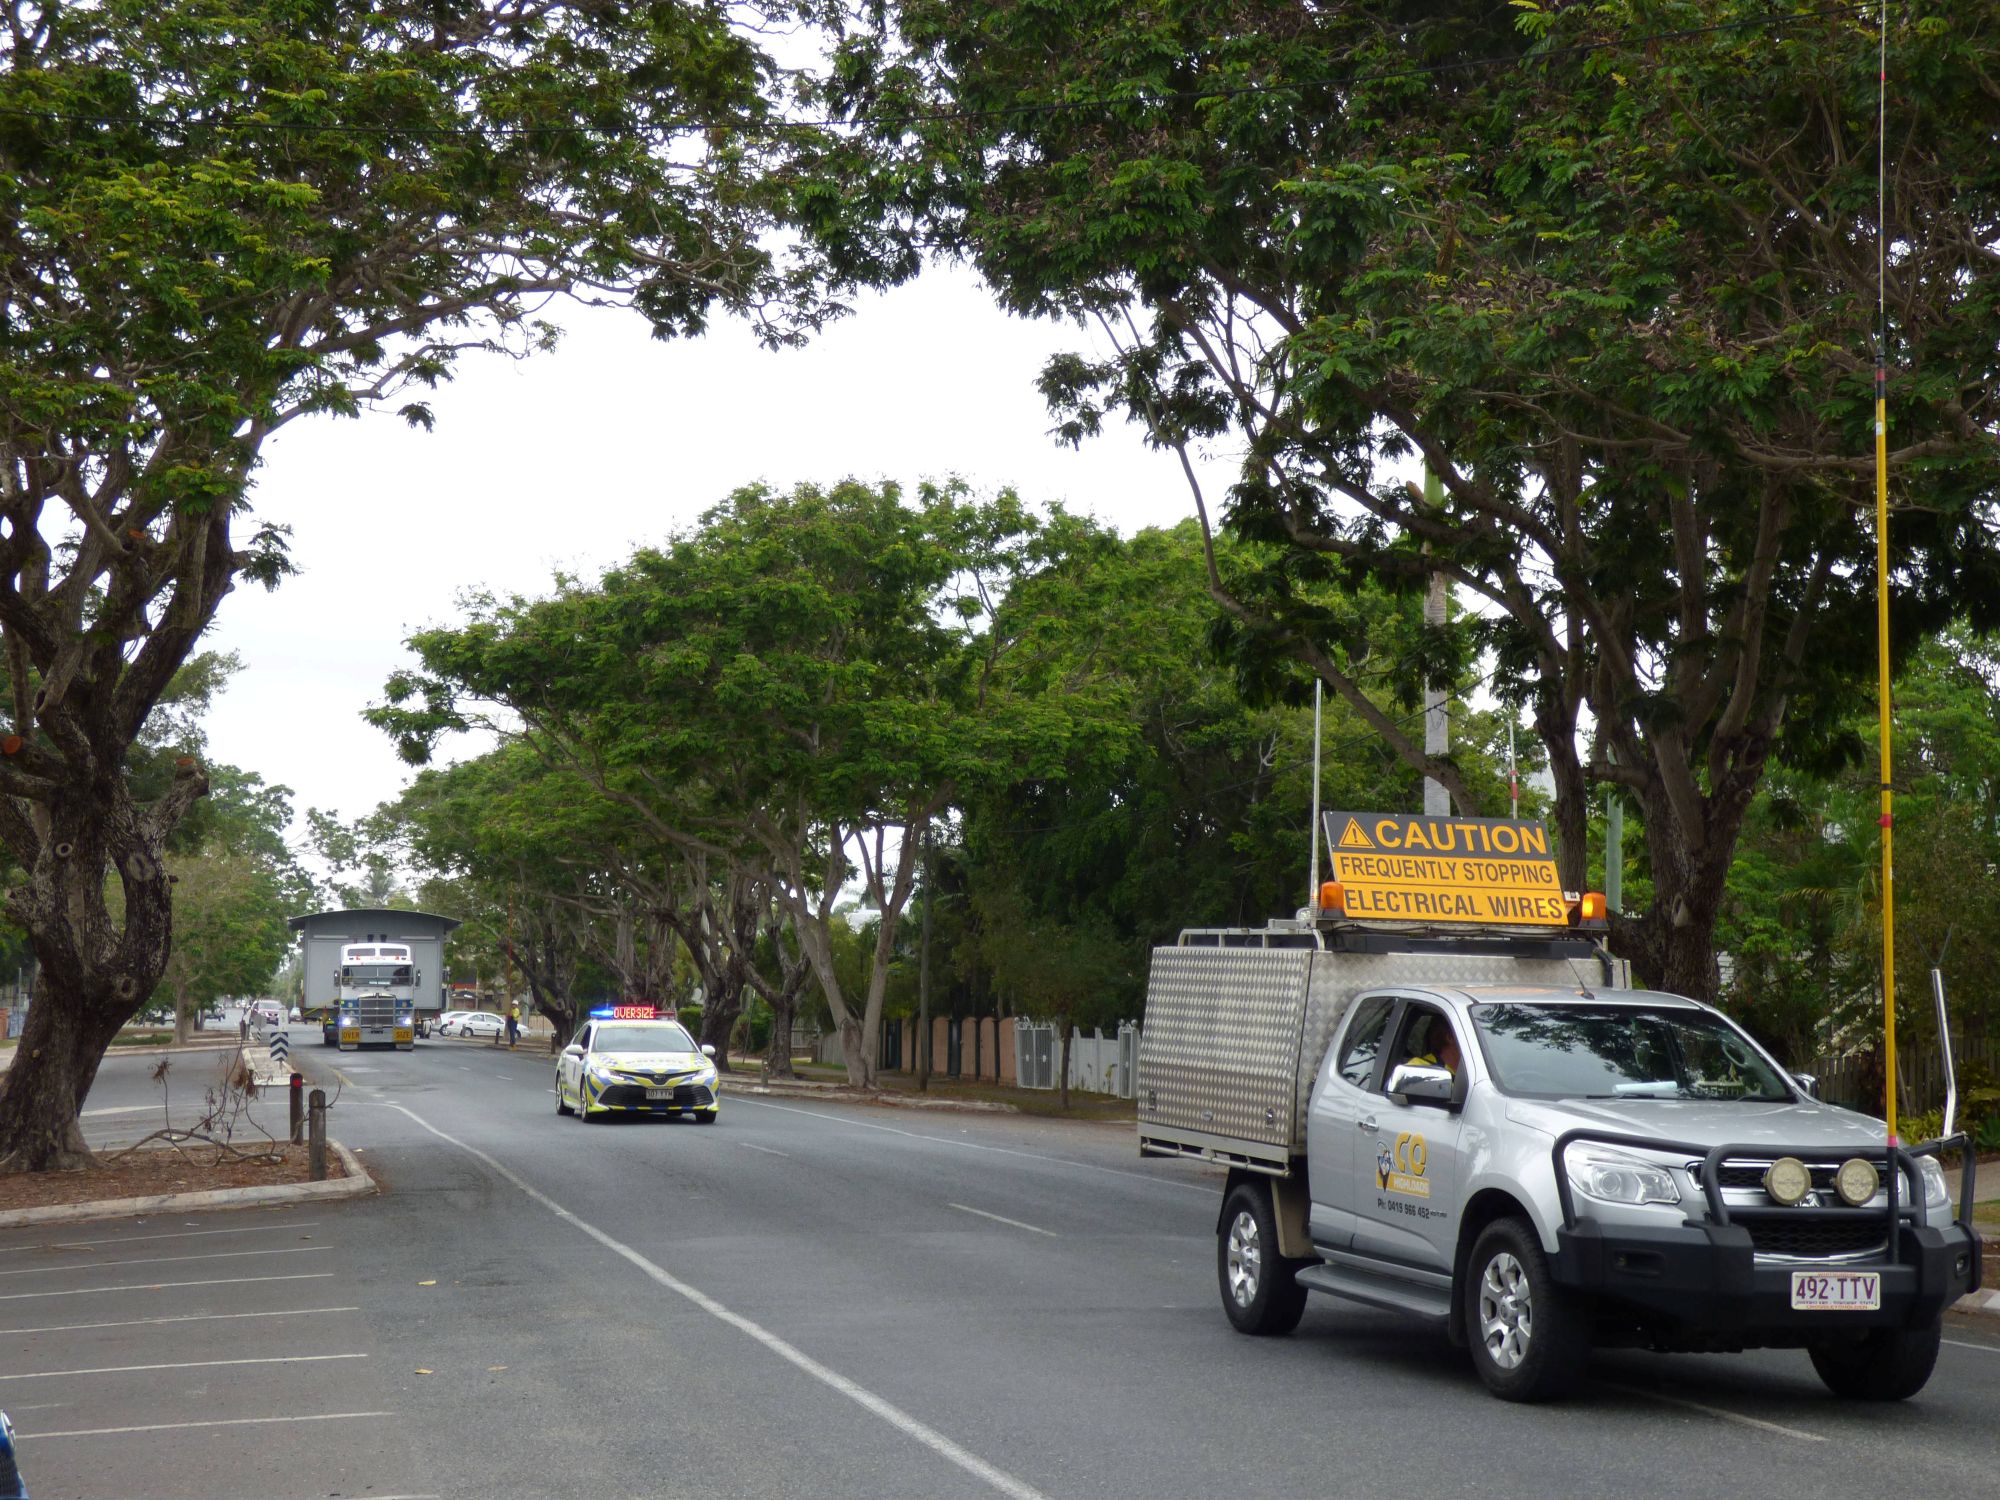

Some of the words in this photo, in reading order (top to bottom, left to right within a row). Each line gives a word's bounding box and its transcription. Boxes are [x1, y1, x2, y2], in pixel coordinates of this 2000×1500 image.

[1375, 820, 1547, 854] CAUTION
[1340, 856, 1457, 881] FREQUENTLY
[1464, 862, 1552, 884] STOPPING
[1344, 889, 1482, 916] ELECTRICAL
[1488, 896, 1563, 919] WIRES
[613, 1007, 655, 1019] OVERSIZE
[396, 1031, 411, 1039] SIZE
